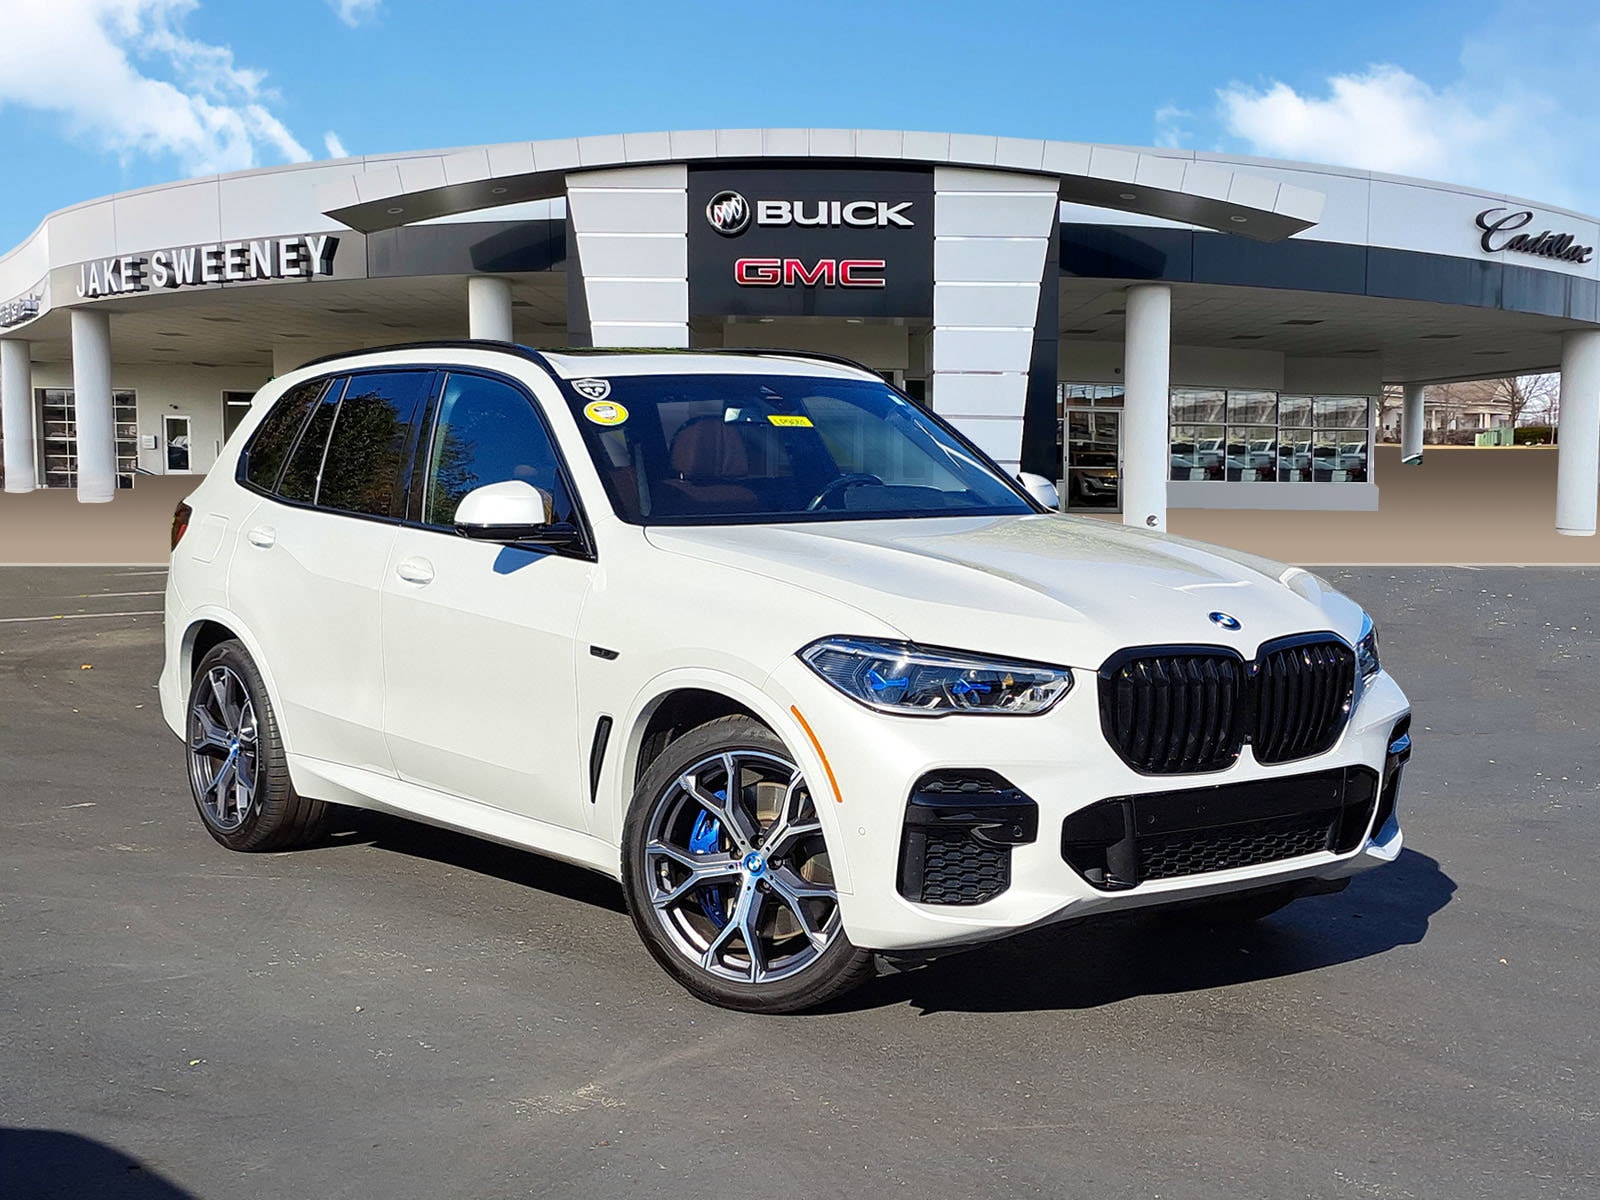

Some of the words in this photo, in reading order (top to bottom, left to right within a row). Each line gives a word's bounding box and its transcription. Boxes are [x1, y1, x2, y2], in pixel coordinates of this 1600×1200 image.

[757, 200, 914, 226] BUICK
[1475, 207, 1593, 264] Cadillac
[76, 256, 140, 299] JAKE
[151, 235, 336, 288] SWEENEY
[735, 258, 886, 286] GMC
